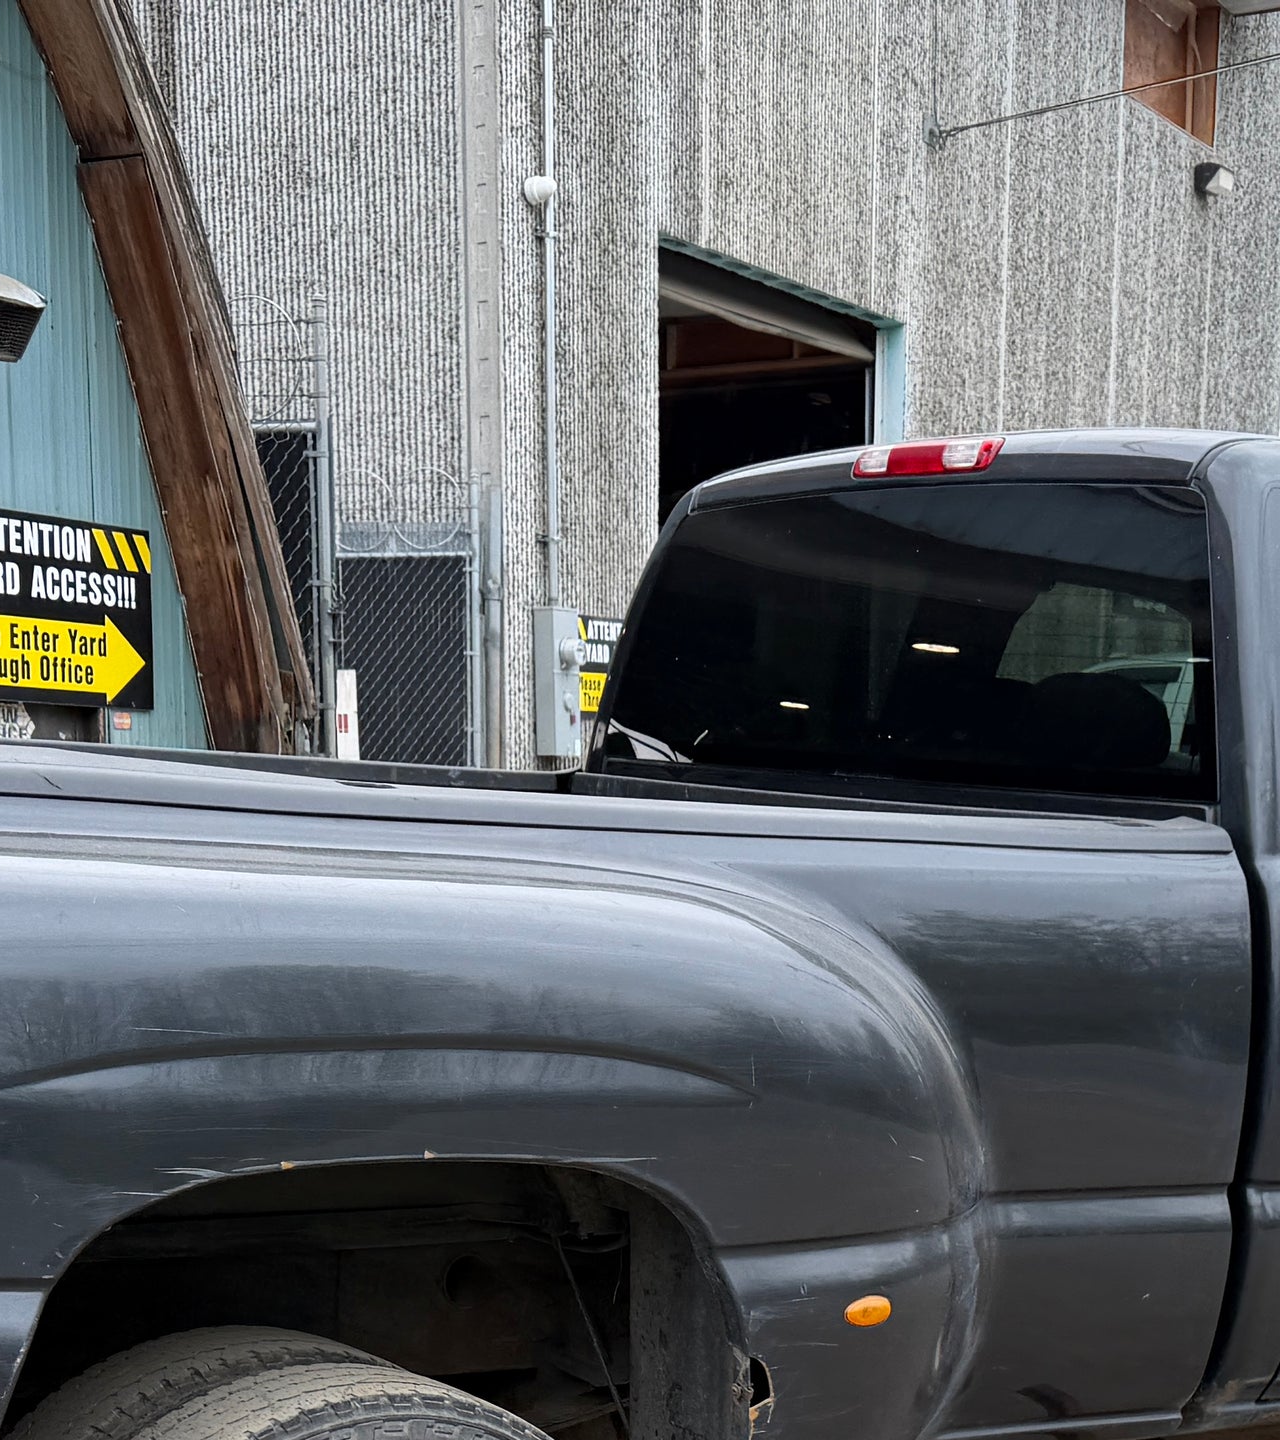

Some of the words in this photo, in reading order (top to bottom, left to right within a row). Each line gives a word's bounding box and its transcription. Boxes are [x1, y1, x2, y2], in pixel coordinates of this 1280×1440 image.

[31, 565, 137, 610] ACCESS!!!
[10, 622, 59, 652] Enter
[68, 628, 108, 658] Yard
[39, 655, 95, 686] Office
